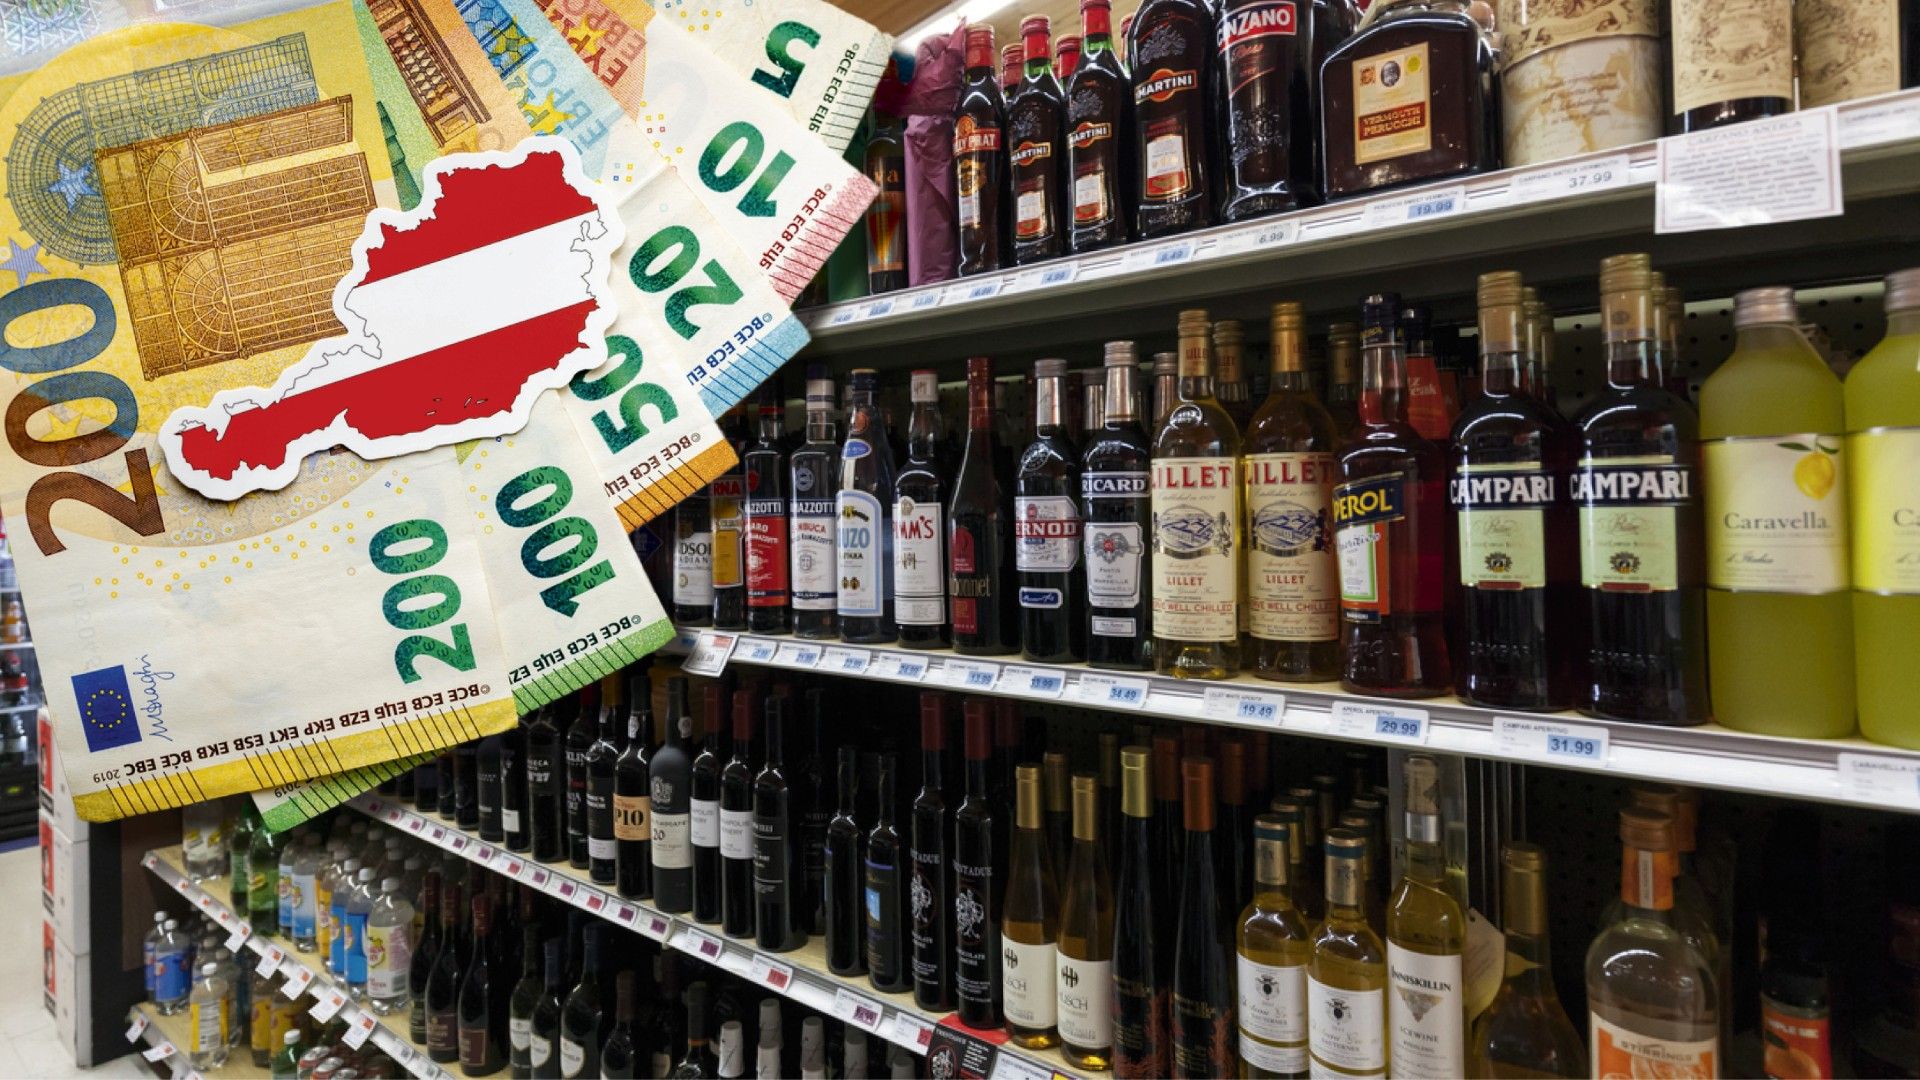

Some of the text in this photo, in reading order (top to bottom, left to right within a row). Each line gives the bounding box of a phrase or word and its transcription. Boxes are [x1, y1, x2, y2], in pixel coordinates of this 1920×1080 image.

[751, 20, 822, 98] 5
[823, 77, 843, 104] ECB
[1137, 74, 1193, 98] MARTINI
[968, 133, 996, 148] PRAT
[698, 120, 797, 217] 10
[1569, 171, 1613, 189] 37.99
[1416, 201, 1453, 217] 19.99
[781, 215, 807, 242] ECB
[629, 225, 744, 340] 20
[706, 340, 736, 368] ECB
[569, 335, 680, 454] 50
[0, 277, 166, 557] 200
[629, 455, 661, 480] ECB
[1152, 465, 1231, 489] ILLET
[1245, 461, 1335, 485] ILLET
[713, 481, 740, 495] RNA
[1082, 479, 1145, 492] RICARD
[1450, 475, 1555, 504] CAMPARI
[1570, 470, 1690, 500] CAMPARI
[1333, 488, 1393, 521] PEROL
[892, 515, 934, 539] MM'S
[1015, 522, 1077, 536] ERNOD
[1724, 511, 1827, 530] Caravella
[495, 466, 616, 618] 100
[679, 542, 712, 555] DSO
[1166, 576, 1204, 586] LILLET
[1266, 574, 1305, 584] LILLET
[369, 519, 477, 684] 200
[1167, 602, 1190, 612] WELL
[1194, 603, 1233, 613] CHILLED
[1267, 601, 1292, 612] WELL
[567, 632, 599, 655] ECB
[508, 665, 531, 685] EZ
[412, 692, 444, 711] ECB
[1242, 703, 1274, 718] 19.49
[1343, 706, 1364, 714] APEROL
[304, 717, 335, 736] EKP
[339, 709, 370, 728] EZB
[1382, 720, 1418, 736] 29.99
[1503, 721, 1532, 730] CAMPARI
[233, 734, 264, 751] ESB
[269, 725, 299, 744] EKT
[196, 742, 230, 760] EKB
[1551, 738, 1594, 755] 31.99
[123, 755, 157, 776] EBC
[93, 769, 121, 783] 2019
[1391, 964, 1451, 992] INNISKILLIN
[1620, 1040, 1693, 1062] STIRRINGS
